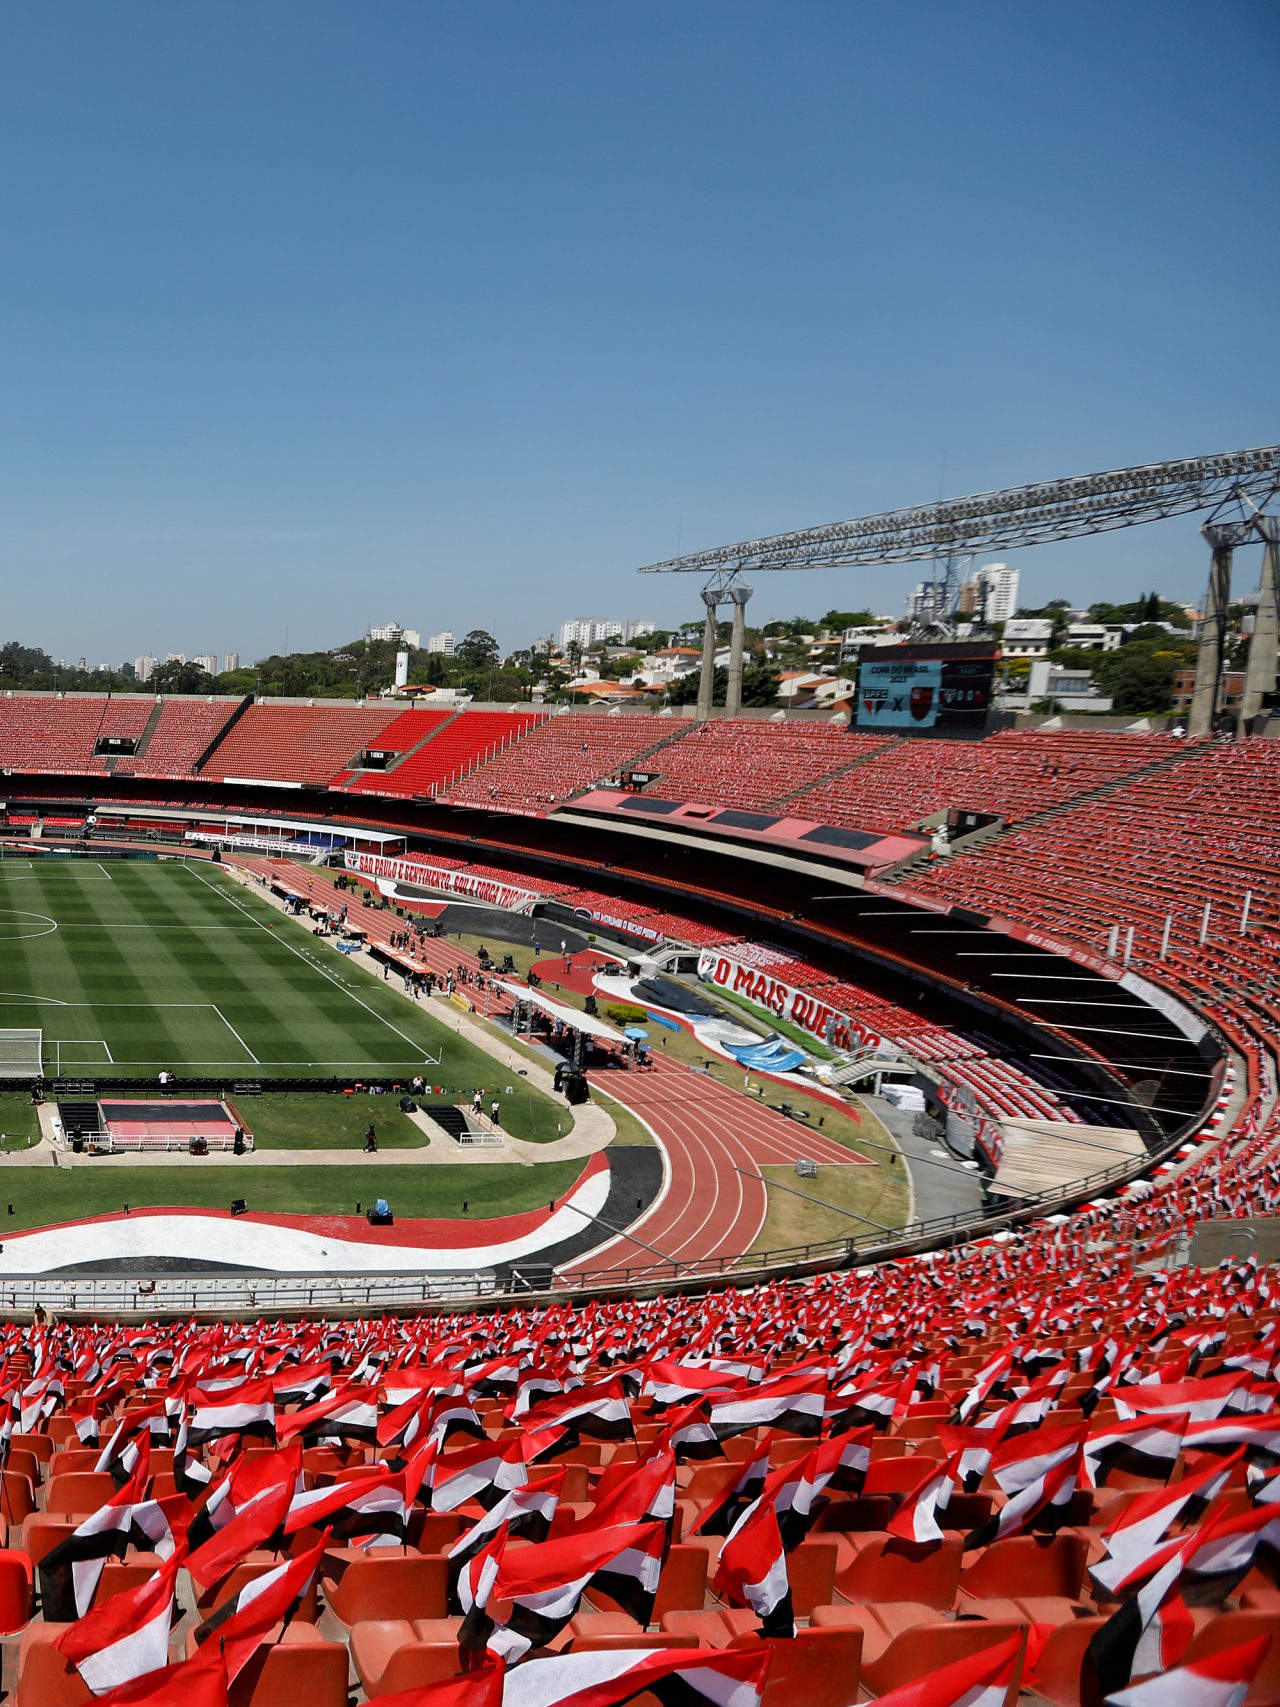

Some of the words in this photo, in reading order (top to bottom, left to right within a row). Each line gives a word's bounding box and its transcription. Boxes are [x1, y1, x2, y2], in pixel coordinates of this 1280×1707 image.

[871, 666, 890, 675] COPA
[891, 666, 901, 674] DO
[902, 665, 930, 674] BRASIL
[890, 676, 907, 684] 2023
[865, 690, 888, 699] SPFC
[892, 697, 904, 712] X
[375, 858, 397, 878] PAULO
[714, 957, 731, 985] O
[733, 964, 788, 1014] MAIS
